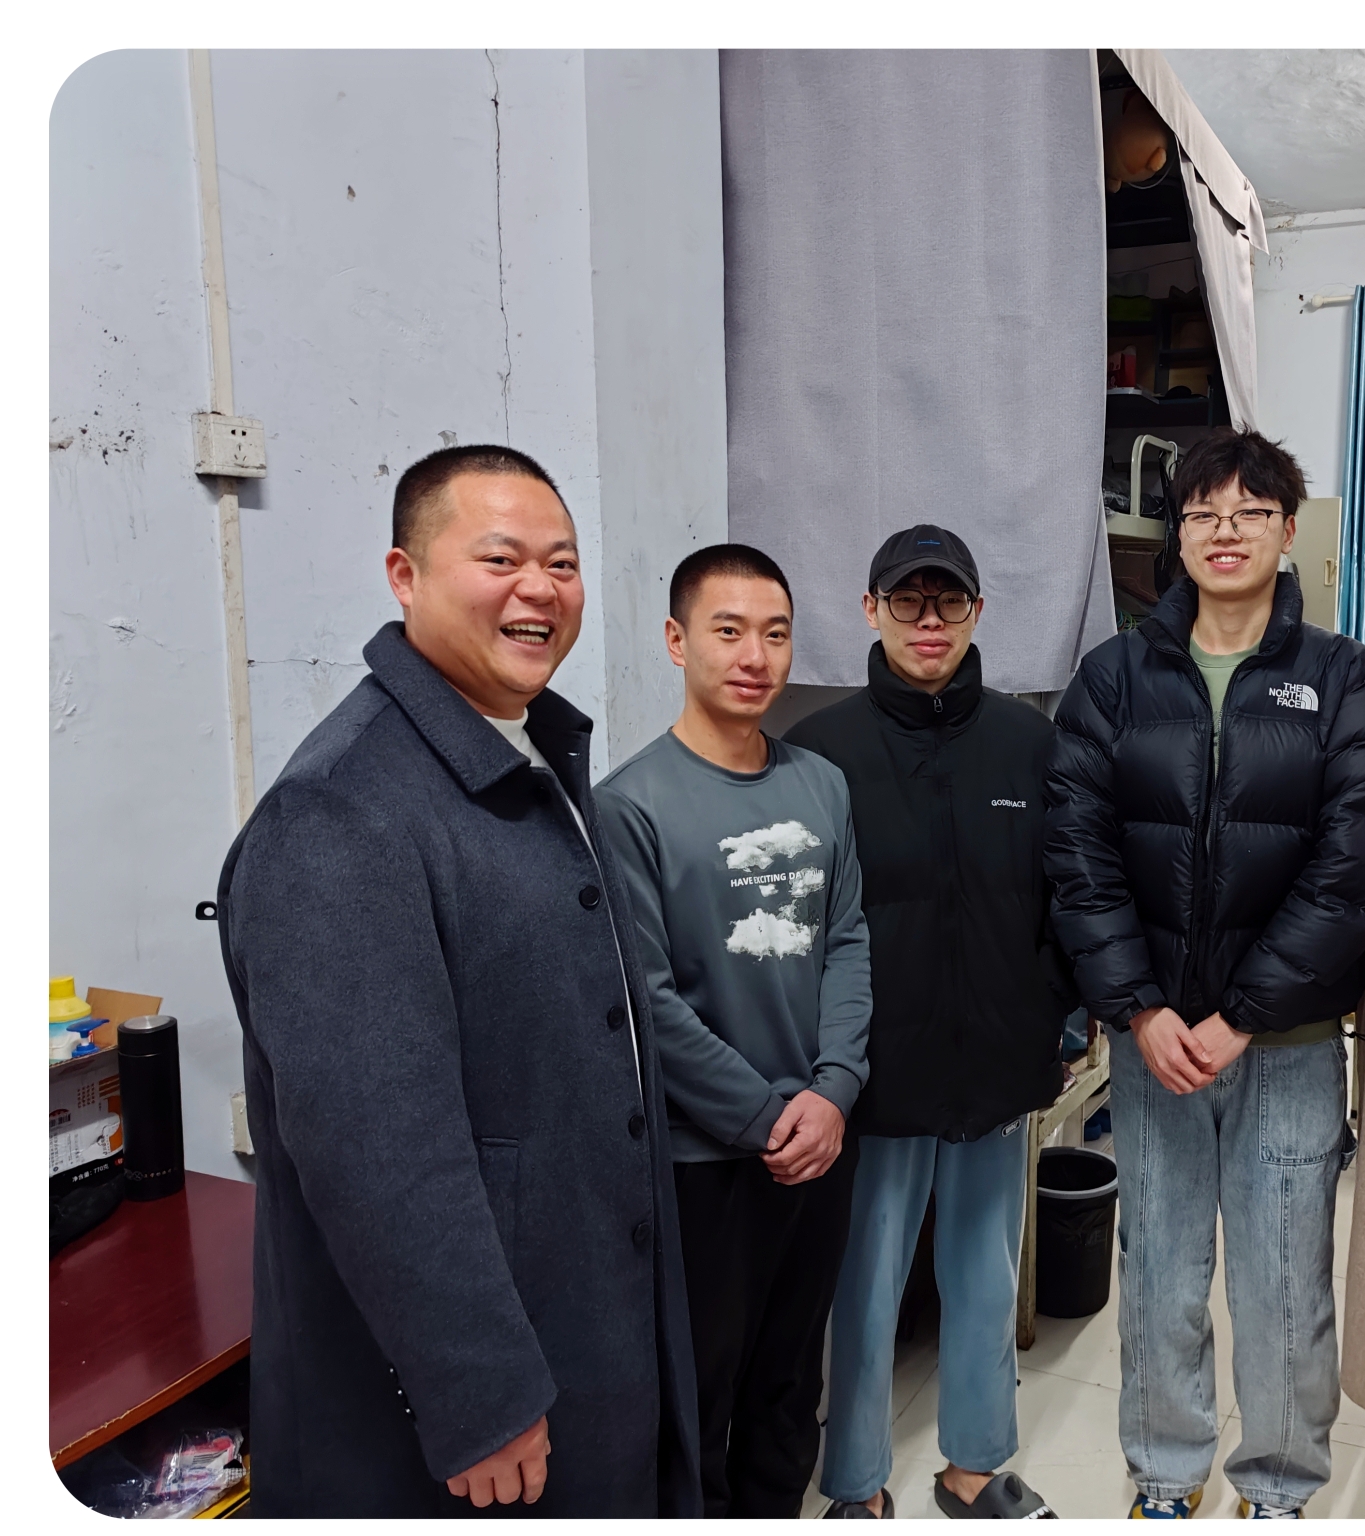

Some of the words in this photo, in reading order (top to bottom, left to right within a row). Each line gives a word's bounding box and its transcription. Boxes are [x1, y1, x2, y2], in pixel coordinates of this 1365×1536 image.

[1283, 682, 1303, 693] THE
[1269, 687, 1302, 701] NORTH
[1277, 697, 1302, 709] FACE
[731, 876, 753, 888] HAVE
